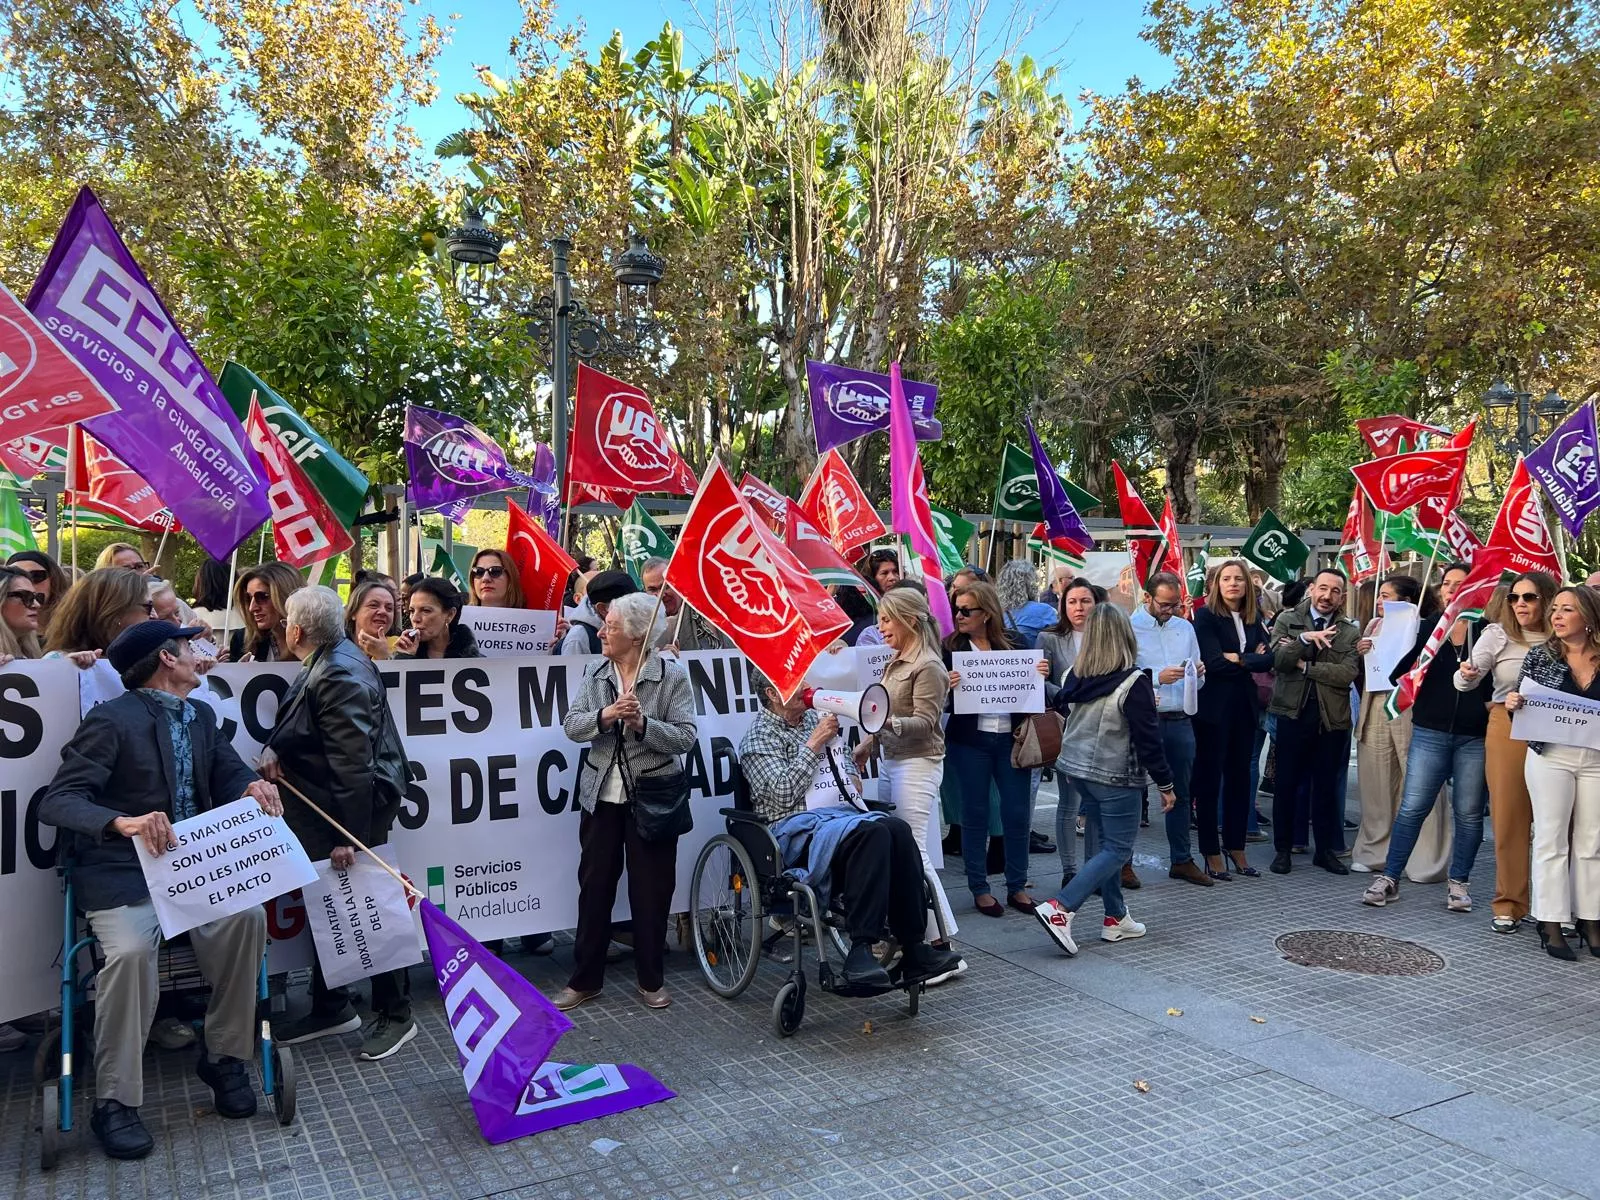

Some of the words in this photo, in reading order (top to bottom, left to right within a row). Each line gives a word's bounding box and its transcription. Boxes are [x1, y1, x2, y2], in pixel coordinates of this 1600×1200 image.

[44, 315, 135, 383] servicios
[136, 379, 149, 395] a
[151, 387, 167, 412] la
[168, 407, 254, 497] ciudadanía
[170, 440, 237, 512] Andalucía
[1263, 536, 1288, 559] CSIF
[473, 621, 537, 635] NUESTR@S
[477, 639, 513, 651] YORES
[516, 641, 534, 651] NO
[962, 659, 979, 668] L@S
[980, 657, 1020, 667] MAYORES
[1021, 657, 1034, 666] NO
[967, 670, 984, 679] SON
[985, 670, 998, 679] UN
[999, 670, 1030, 679] GASTO!
[961, 684, 983, 692] SOLO
[984, 684, 998, 692] LES
[999, 683, 1036, 691] IMPORTA
[991, 696, 1018, 704] PACTO
[1524, 699, 1565, 711] 100X100
[1566, 704, 1580, 713] EN
[1582, 707, 1594, 716] LA
[1554, 715, 1573, 725] DEL
[1574, 718, 1588, 726] PP
[449, 754, 519, 826] DE
[190, 810, 255, 842] MAYORES
[257, 806, 267, 818] N
[171, 851, 204, 872] SON
[205, 842, 228, 860] UN
[230, 824, 278, 849] GASTO!
[167, 874, 207, 898] SOLO
[208, 864, 233, 882] LES
[235, 842, 294, 872] IMPORTA
[454, 860, 522, 878] Servicios
[208, 891, 225, 905] EL
[227, 871, 272, 898] PACTO
[337, 870, 353, 896] LÍNE
[455, 880, 518, 898] Públicos
[344, 895, 357, 911] LA
[364, 895, 377, 910] PP
[457, 894, 541, 920] Andalucía
[322, 893, 348, 956] PRIVATIZAR
[348, 912, 361, 928] EN
[369, 910, 383, 932] DEL
[353, 929, 374, 971] 100X100
